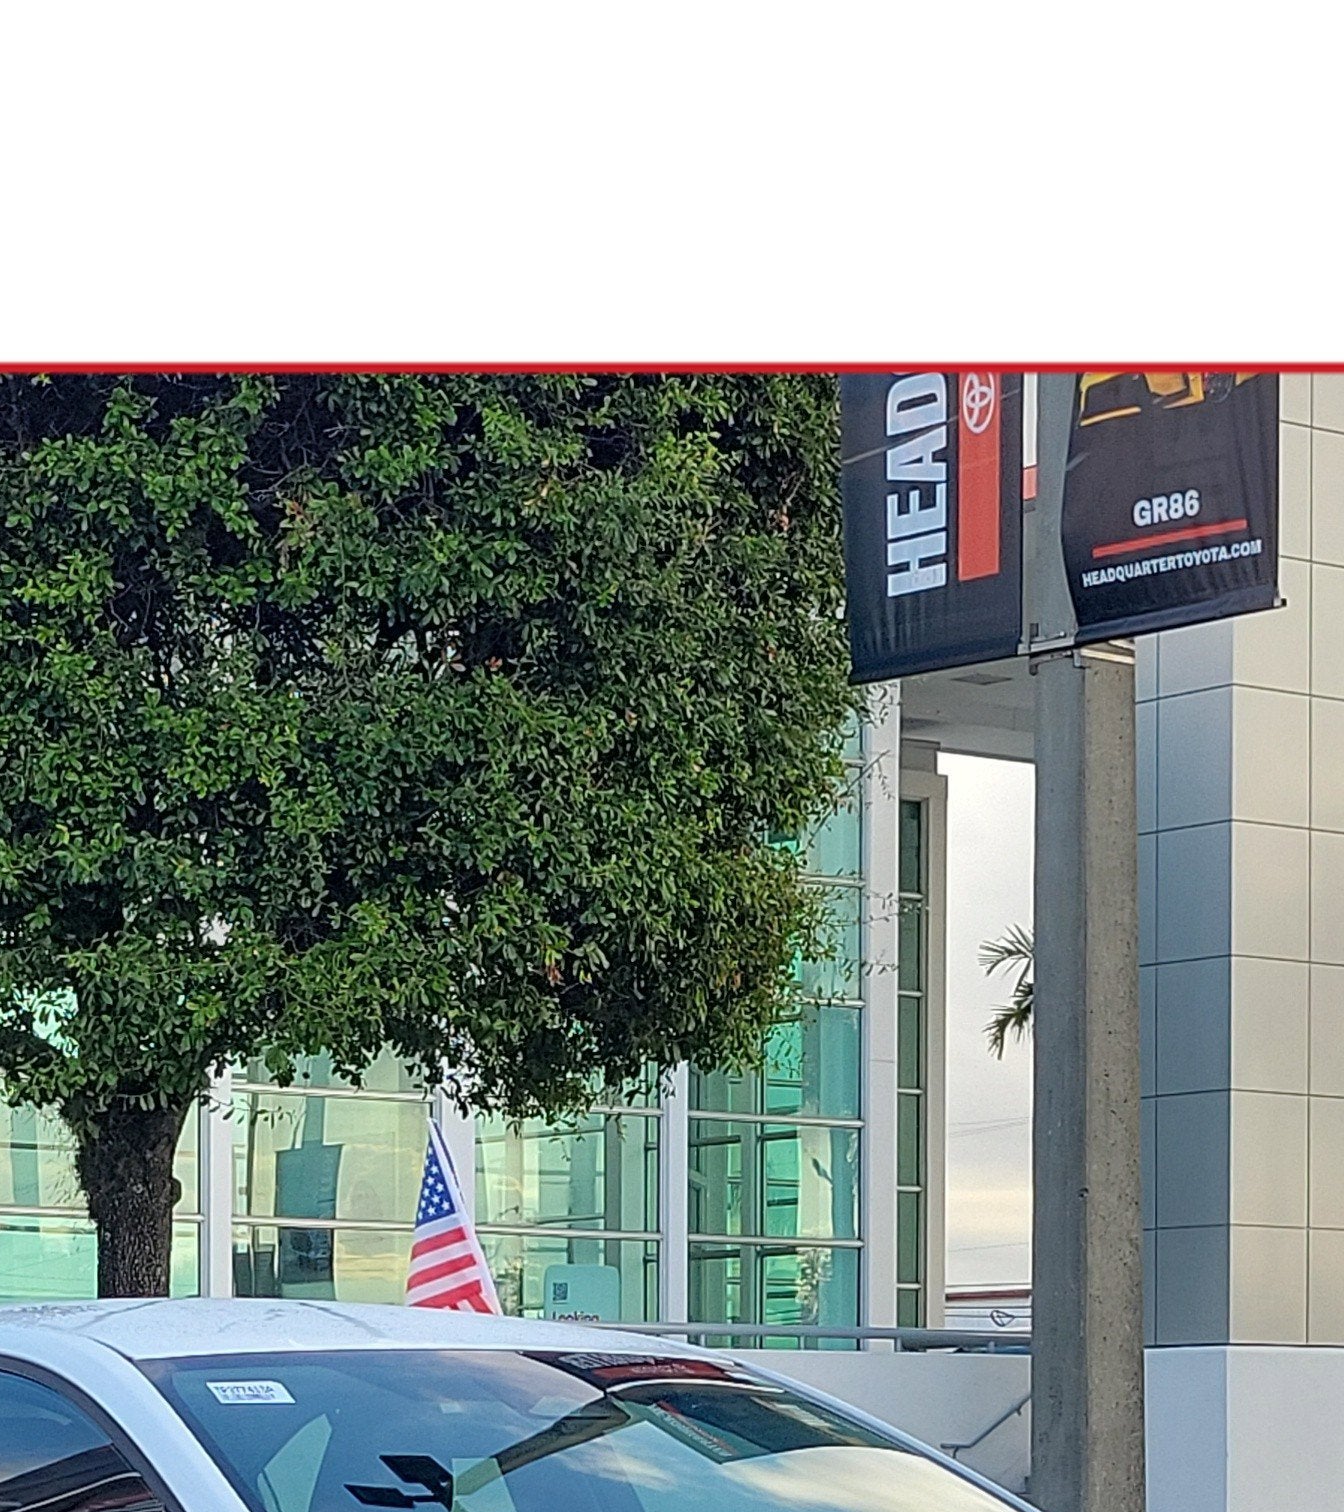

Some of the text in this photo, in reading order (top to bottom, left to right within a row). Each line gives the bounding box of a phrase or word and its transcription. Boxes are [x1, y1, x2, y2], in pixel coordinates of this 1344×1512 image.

[886, 372, 947, 597] HEAD
[1133, 489, 1200, 527] GR86
[1081, 539, 1262, 588] HEADQUARTERTOYOTA.COM
